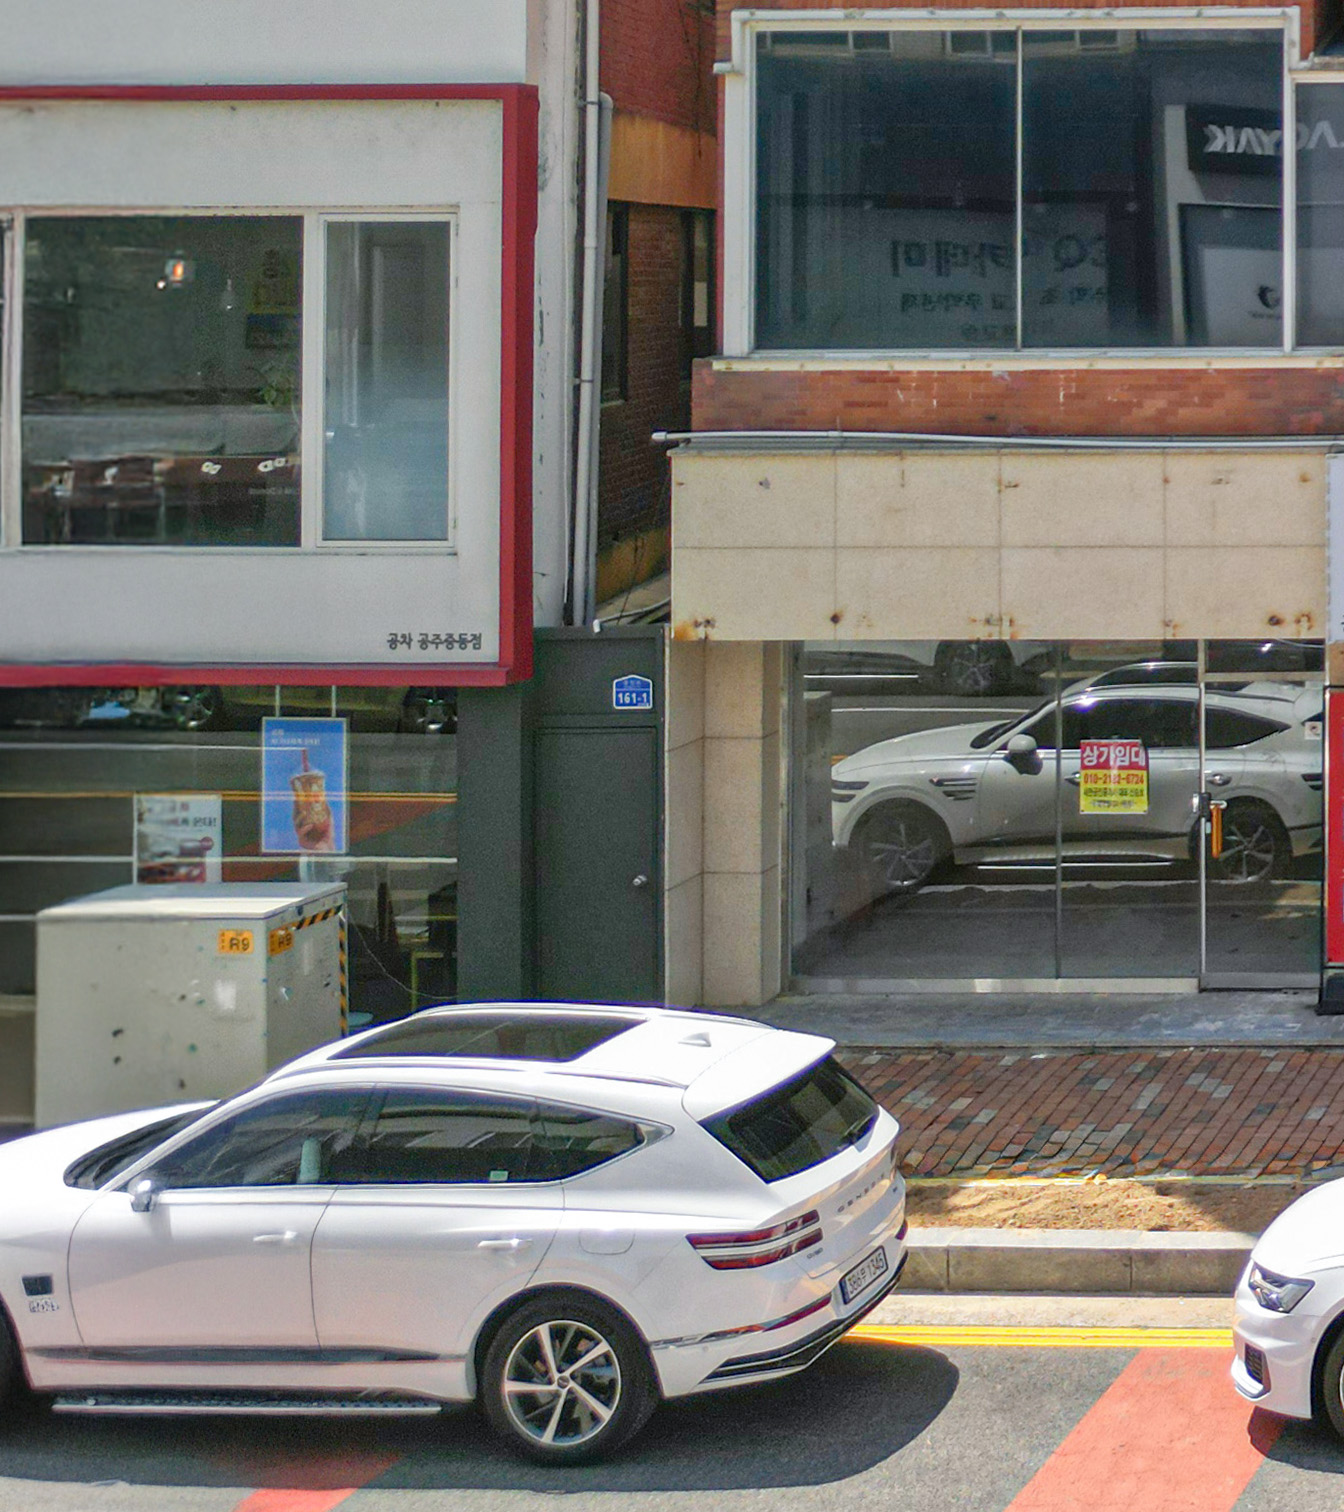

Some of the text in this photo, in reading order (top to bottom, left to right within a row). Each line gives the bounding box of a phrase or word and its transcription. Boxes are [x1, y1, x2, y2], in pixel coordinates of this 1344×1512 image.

[387, 632, 483, 651] 공차 공주중동점
[617, 692, 648, 704] 161-1
[1083, 746, 1146, 767] 상가임대
[229, 936, 250, 952] R9
